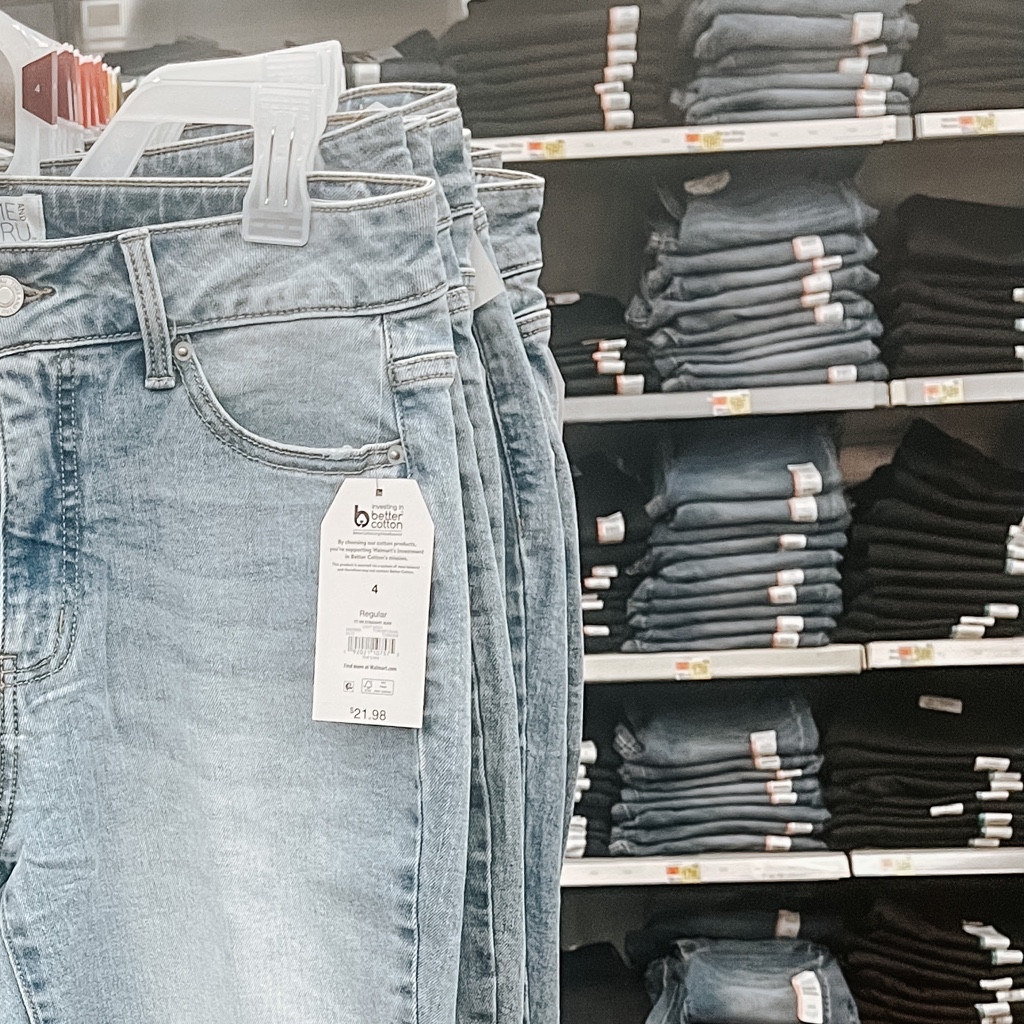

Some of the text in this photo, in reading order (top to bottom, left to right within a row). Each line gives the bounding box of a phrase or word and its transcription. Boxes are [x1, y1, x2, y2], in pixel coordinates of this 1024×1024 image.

[17, 203, 27, 222] AND
[371, 511, 403, 521] better
[371, 520, 403, 529] cotton
[371, 584, 378, 594] 4
[359, 610, 387, 619] Regular
[349, 706, 387, 721] $21.98
